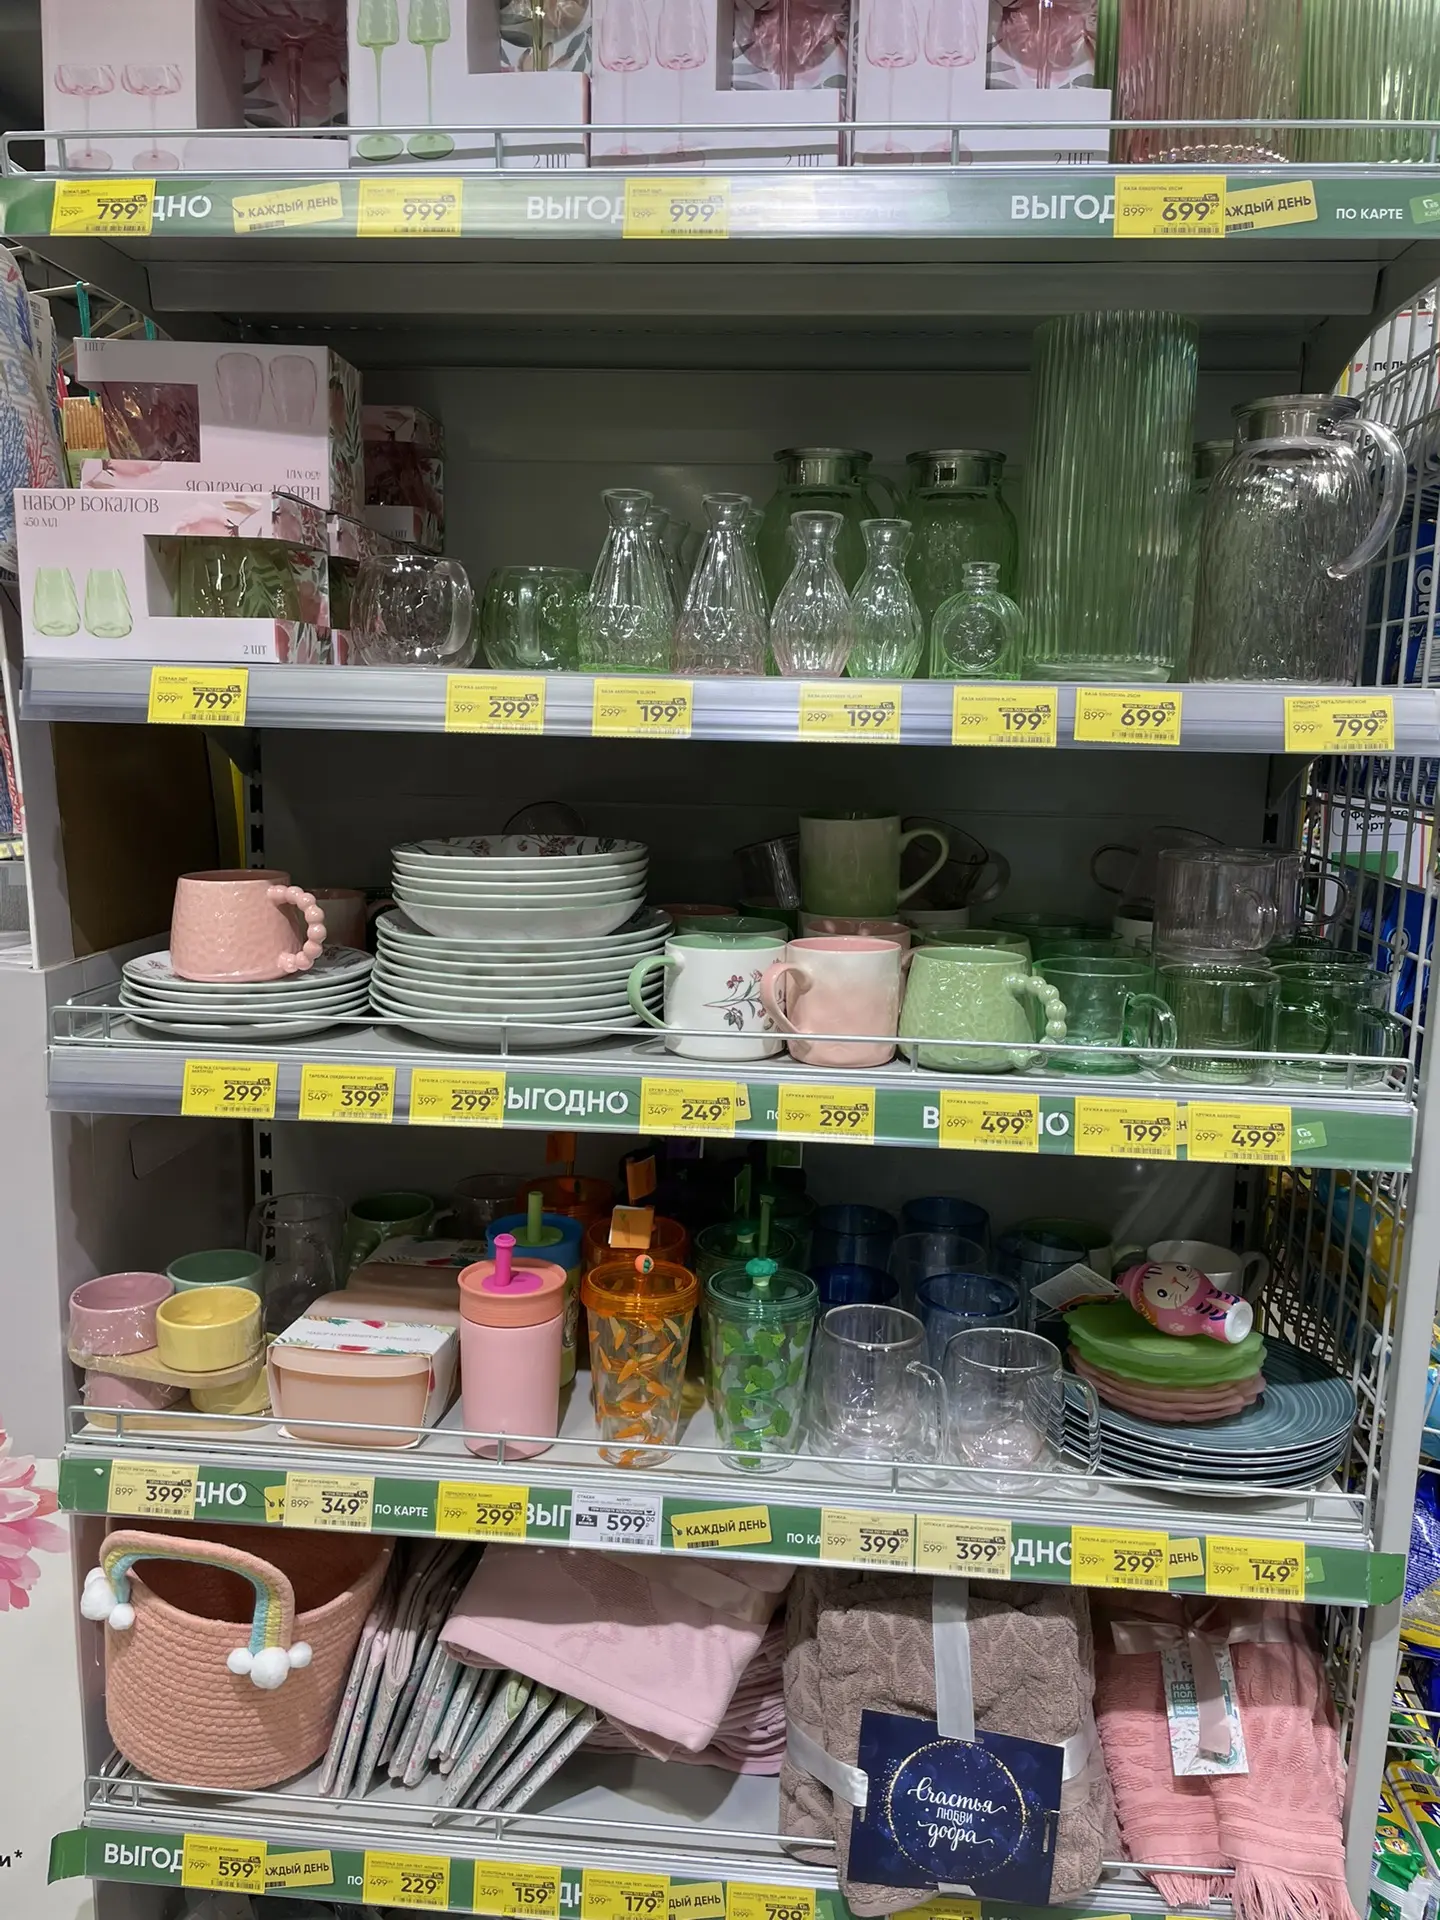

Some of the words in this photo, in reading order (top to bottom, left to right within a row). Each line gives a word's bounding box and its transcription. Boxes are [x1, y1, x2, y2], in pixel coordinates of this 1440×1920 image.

[97, 203, 138, 219] 799
[248, 200, 304, 217] КАЖДЫЙ
[306, 196, 338, 211] ДЕНЬ
[1163, 203, 1209, 220] 699
[1278, 195, 1311, 211] ДЕНЬ
[403, 204, 448, 220] 999
[670, 204, 714, 221] 999
[1336, 208, 1357, 219] ПО
[1361, 208, 1403, 219] КАРТЕ
[23, 494, 75, 513] НАБОР
[81, 495, 159, 514] БОКАЛОВ
[243, 646, 249, 655] 2
[251, 646, 267, 655] ШТ
[194, 692, 232, 709] 799
[488, 702, 531, 718] 299
[640, 706, 679, 722] 199
[847, 710, 886, 727] 199
[1120, 710, 1166, 727] 699
[1002, 713, 1042, 730] 199
[1333, 719, 1378, 736] 799
[223, 1085, 262, 1101] 299
[341, 1090, 380, 1107] 399
[505, 1087, 628, 1116] ЫГОДНО
[451, 1095, 490, 1111] 299
[681, 1104, 722, 1120] 249
[820, 1110, 860, 1127] 299
[981, 1116, 1024, 1134] 499
[1123, 1125, 1162, 1142] 199
[1231, 1130, 1276, 1148] 499
[146, 1486, 183, 1503] 399
[321, 1498, 360, 1515] 349
[375, 1504, 391, 1515] ПО
[394, 1504, 428, 1517] КАРТЕ
[476, 1508, 514, 1526] 299
[607, 1514, 646, 1532] 599
[686, 1519, 735, 1536] КАЖДЫЙ
[738, 1519, 767, 1533] ДЕНЬ
[786, 1533, 804, 1544] ПО
[860, 1535, 900, 1553] 399
[956, 1543, 996, 1561] 399
[1011, 1538, 1072, 1567] ДНО
[1169, 1552, 1198, 1565] ДЕНЬ
[1114, 1554, 1154, 1573] 299
[1252, 1564, 1290, 1582] 149
[1174, 1690, 1196, 1698] ПОЛ
[936, 1806, 973, 1825] ЛЮБВИ
[218, 1861, 253, 1878] 599
[304, 1862, 329, 1874] ДЕНЬ
[348, 1875, 363, 1886] ПО
[401, 1877, 436, 1895] 229
[515, 1887, 547, 1904] 159
[669, 1896, 692, 1909] ДЫЙ
[694, 1894, 720, 1907] ДЕНЬ
[625, 1896, 656, 1913] 179
